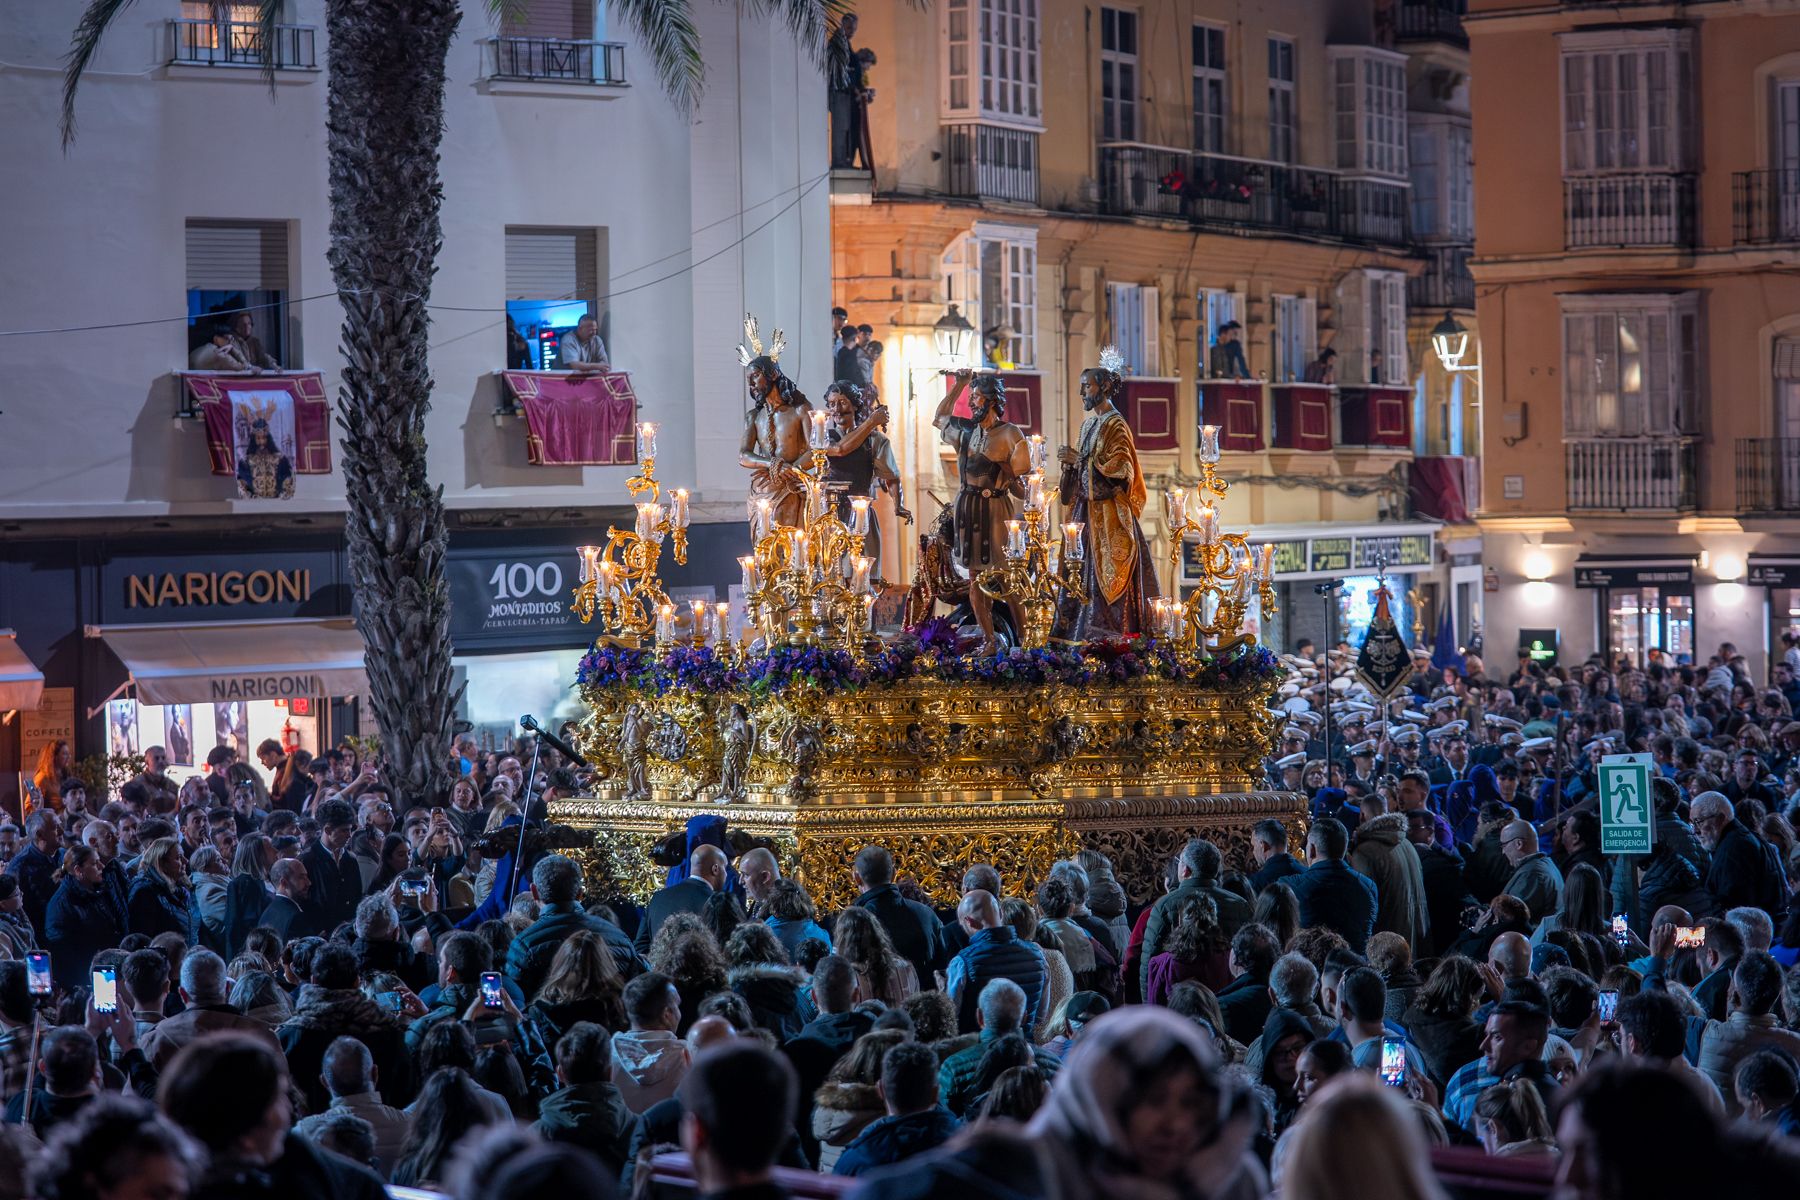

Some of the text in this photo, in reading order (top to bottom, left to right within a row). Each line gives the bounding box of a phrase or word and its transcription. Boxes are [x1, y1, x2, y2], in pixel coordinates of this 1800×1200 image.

[129, 568, 310, 608] NARIGONI
[489, 562, 562, 599] 100
[488, 601, 562, 618] MONTADITOS
[212, 675, 315, 699] NARIGONI
[26, 727, 70, 737] COFFEE
